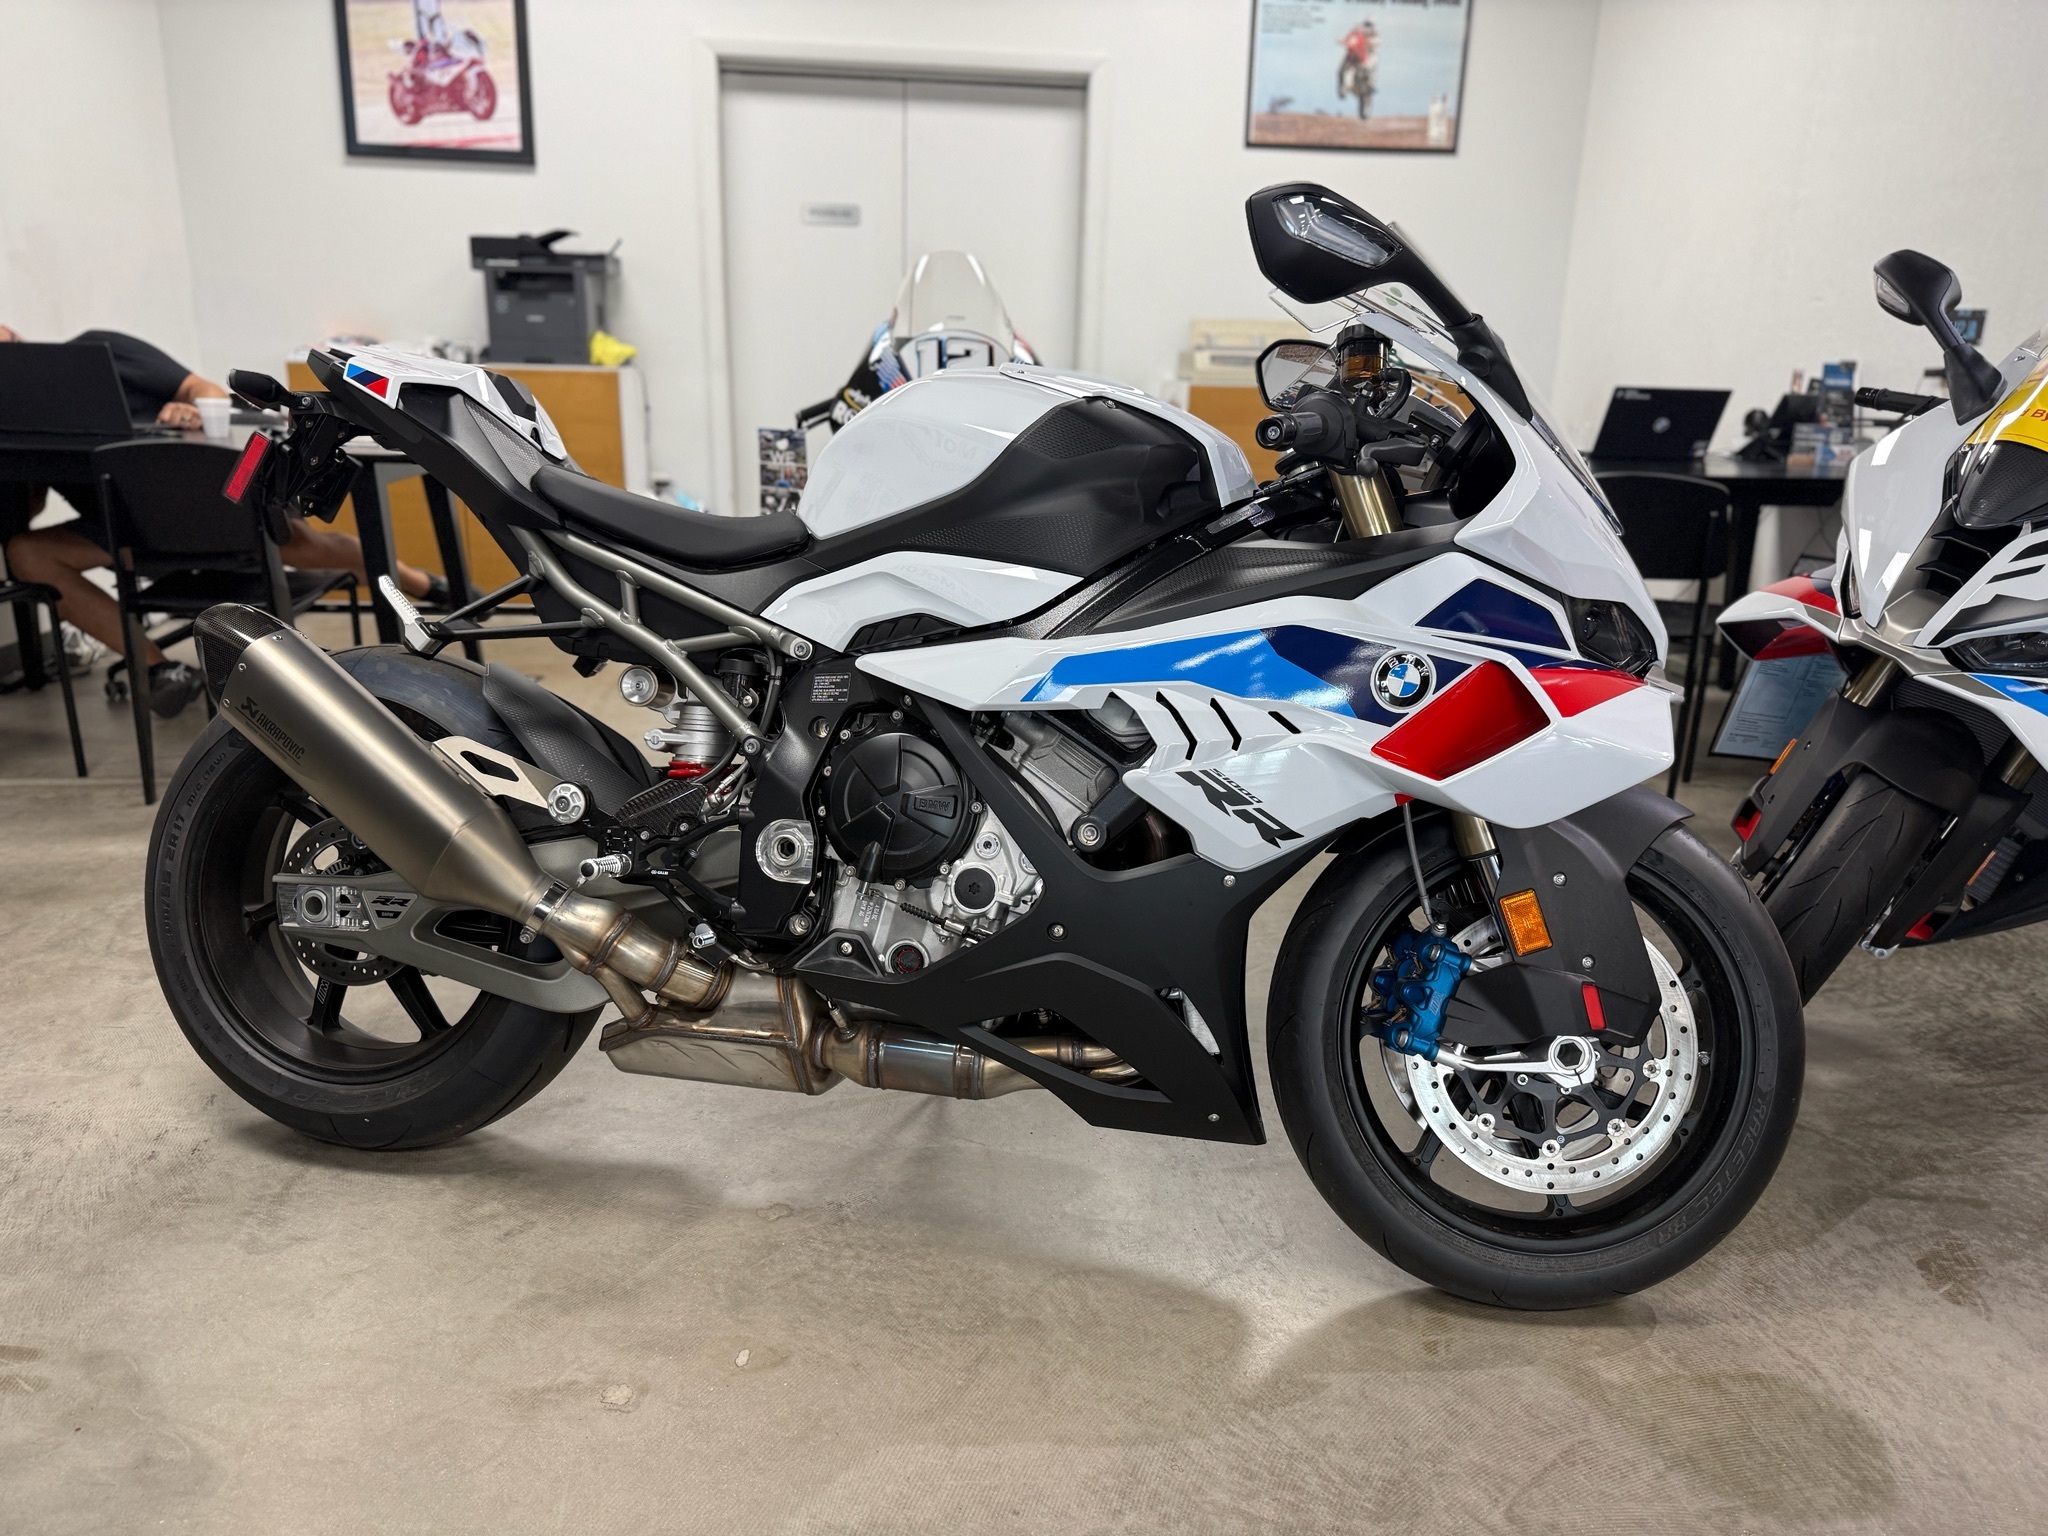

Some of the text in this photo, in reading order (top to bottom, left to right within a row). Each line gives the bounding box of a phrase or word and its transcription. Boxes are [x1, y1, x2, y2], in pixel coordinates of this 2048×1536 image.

[1209, 768, 1264, 804] S1000
[918, 799, 951, 812] BMW
[1175, 769, 1305, 849] RR
